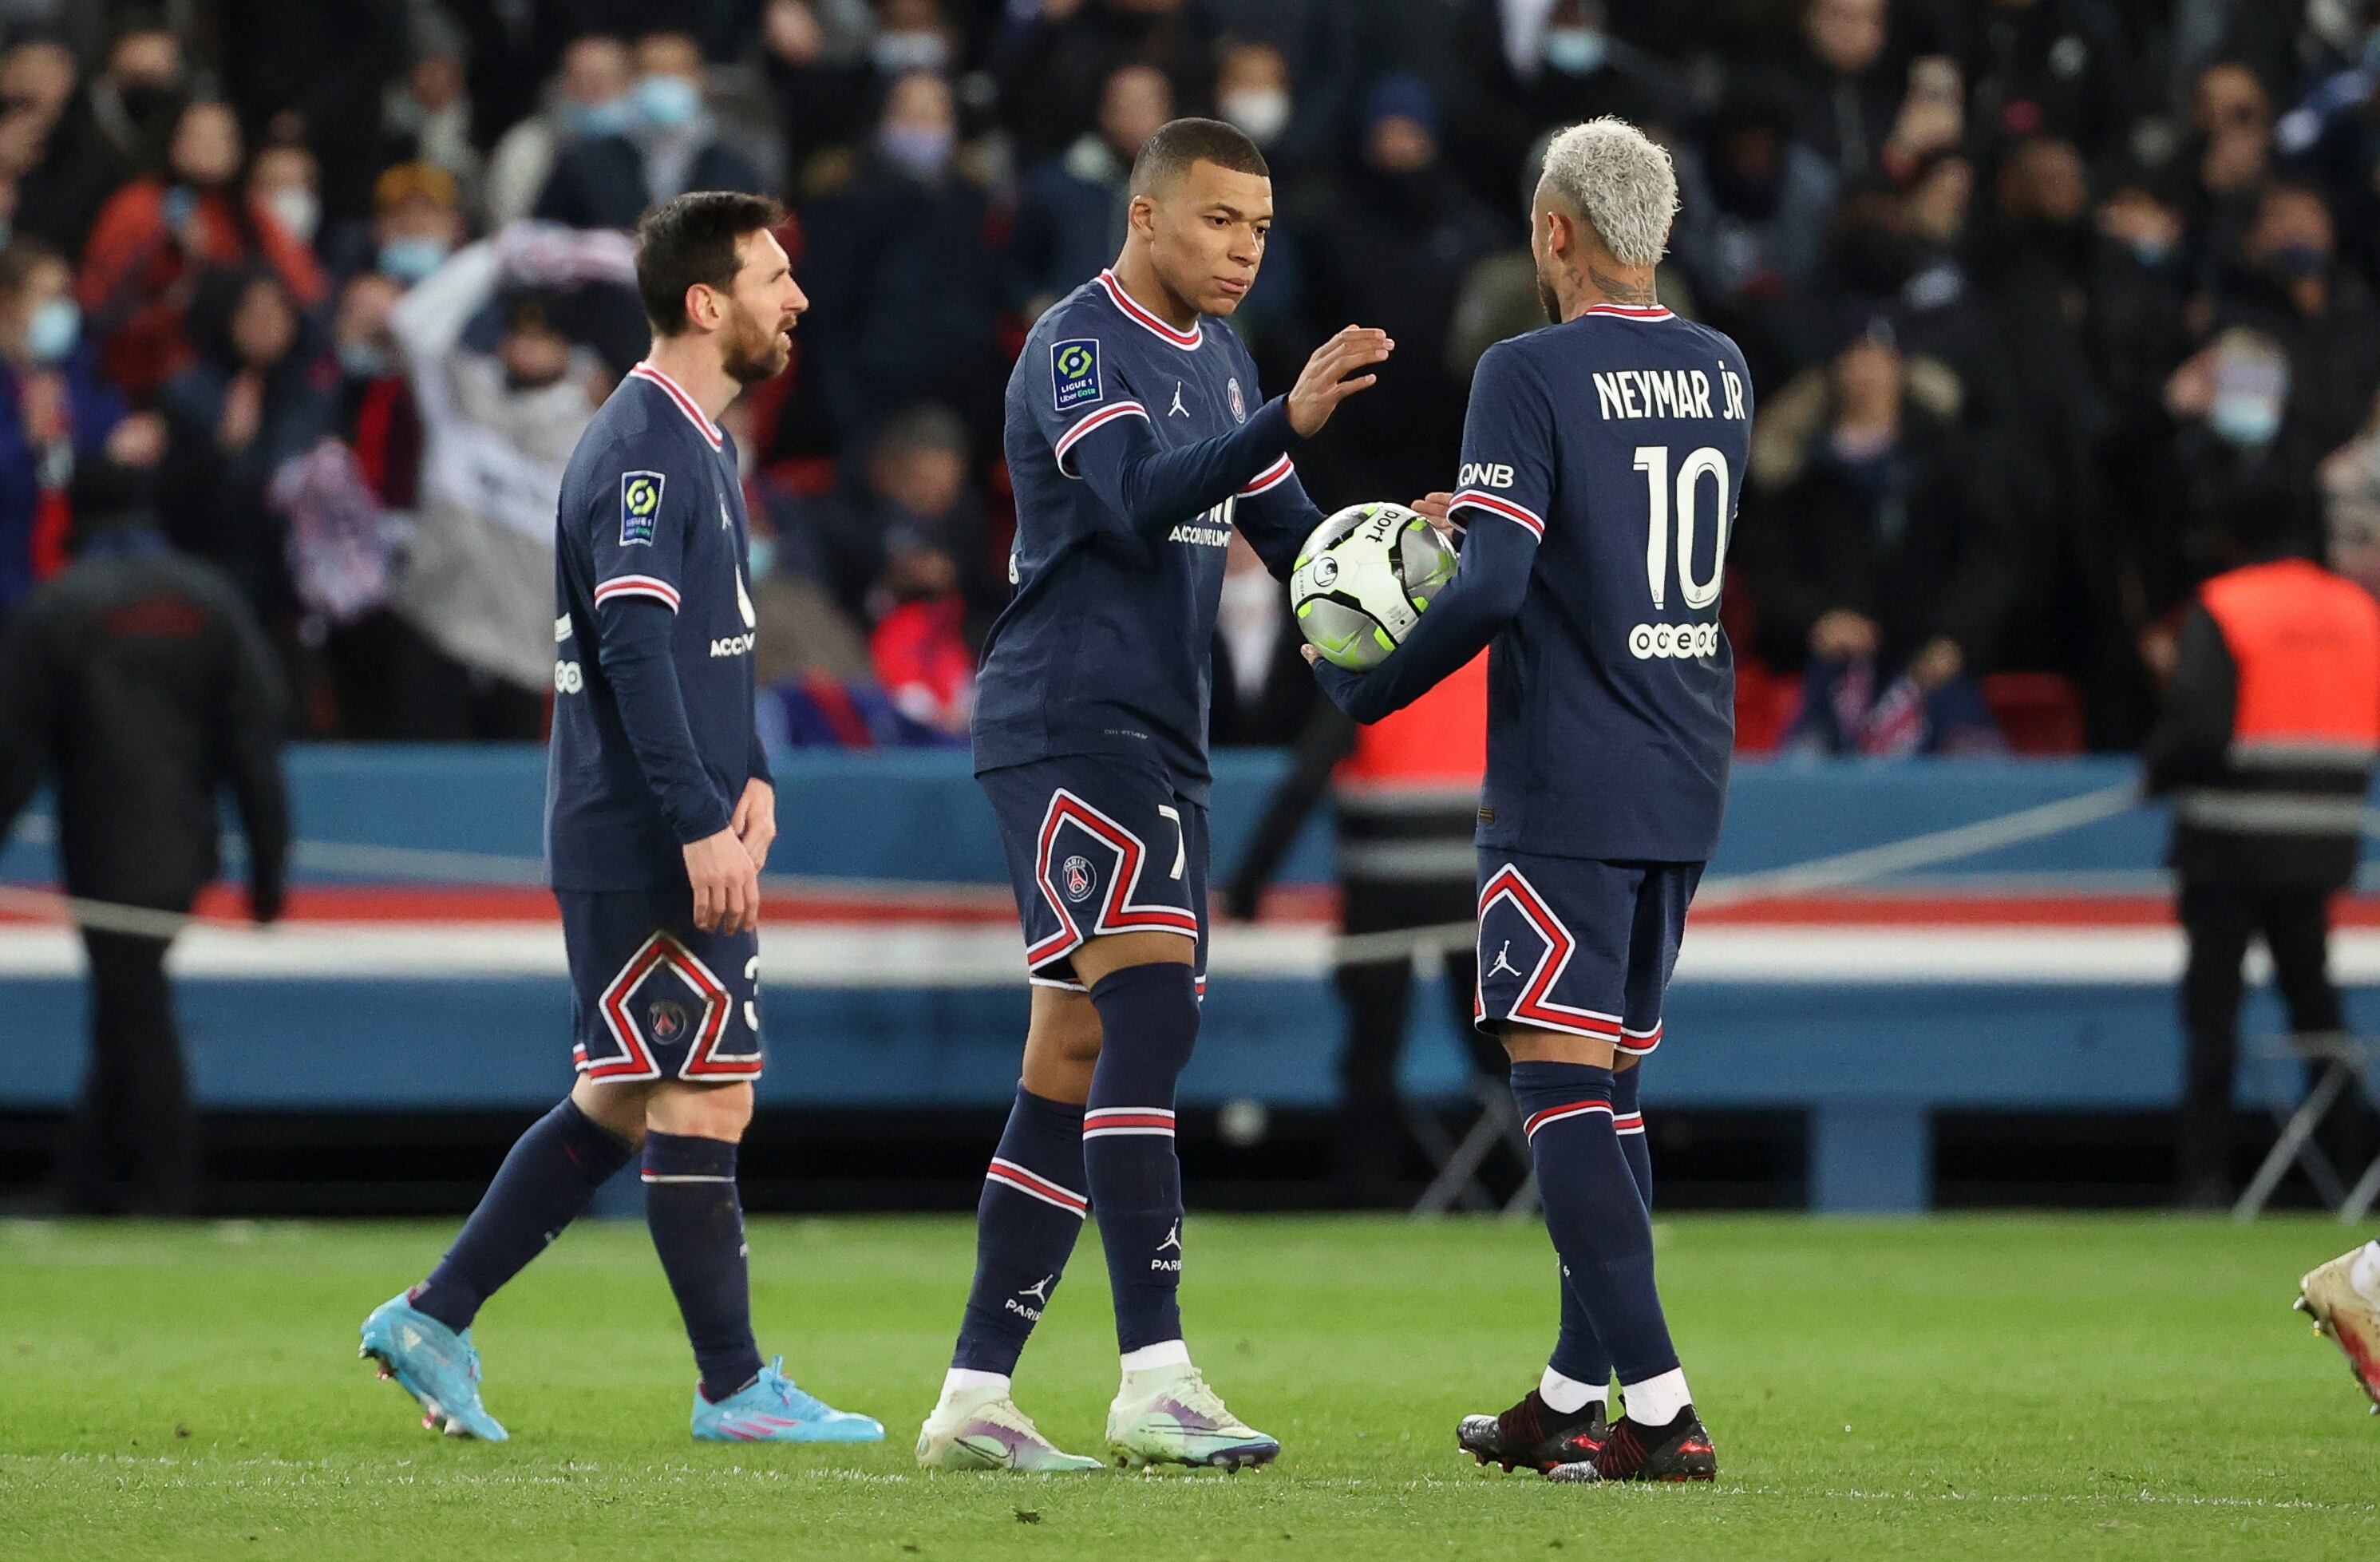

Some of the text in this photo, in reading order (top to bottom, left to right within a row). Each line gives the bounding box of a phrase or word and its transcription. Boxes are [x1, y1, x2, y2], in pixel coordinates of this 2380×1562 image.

[1060, 393, 1077, 402] Uber
[1061, 379, 1085, 393] LIGUE
[1591, 370, 1714, 420] NEYMAR
[1459, 462, 1514, 488] QNB
[1632, 445, 1730, 611] 10
[1158, 804, 1185, 880] 7
